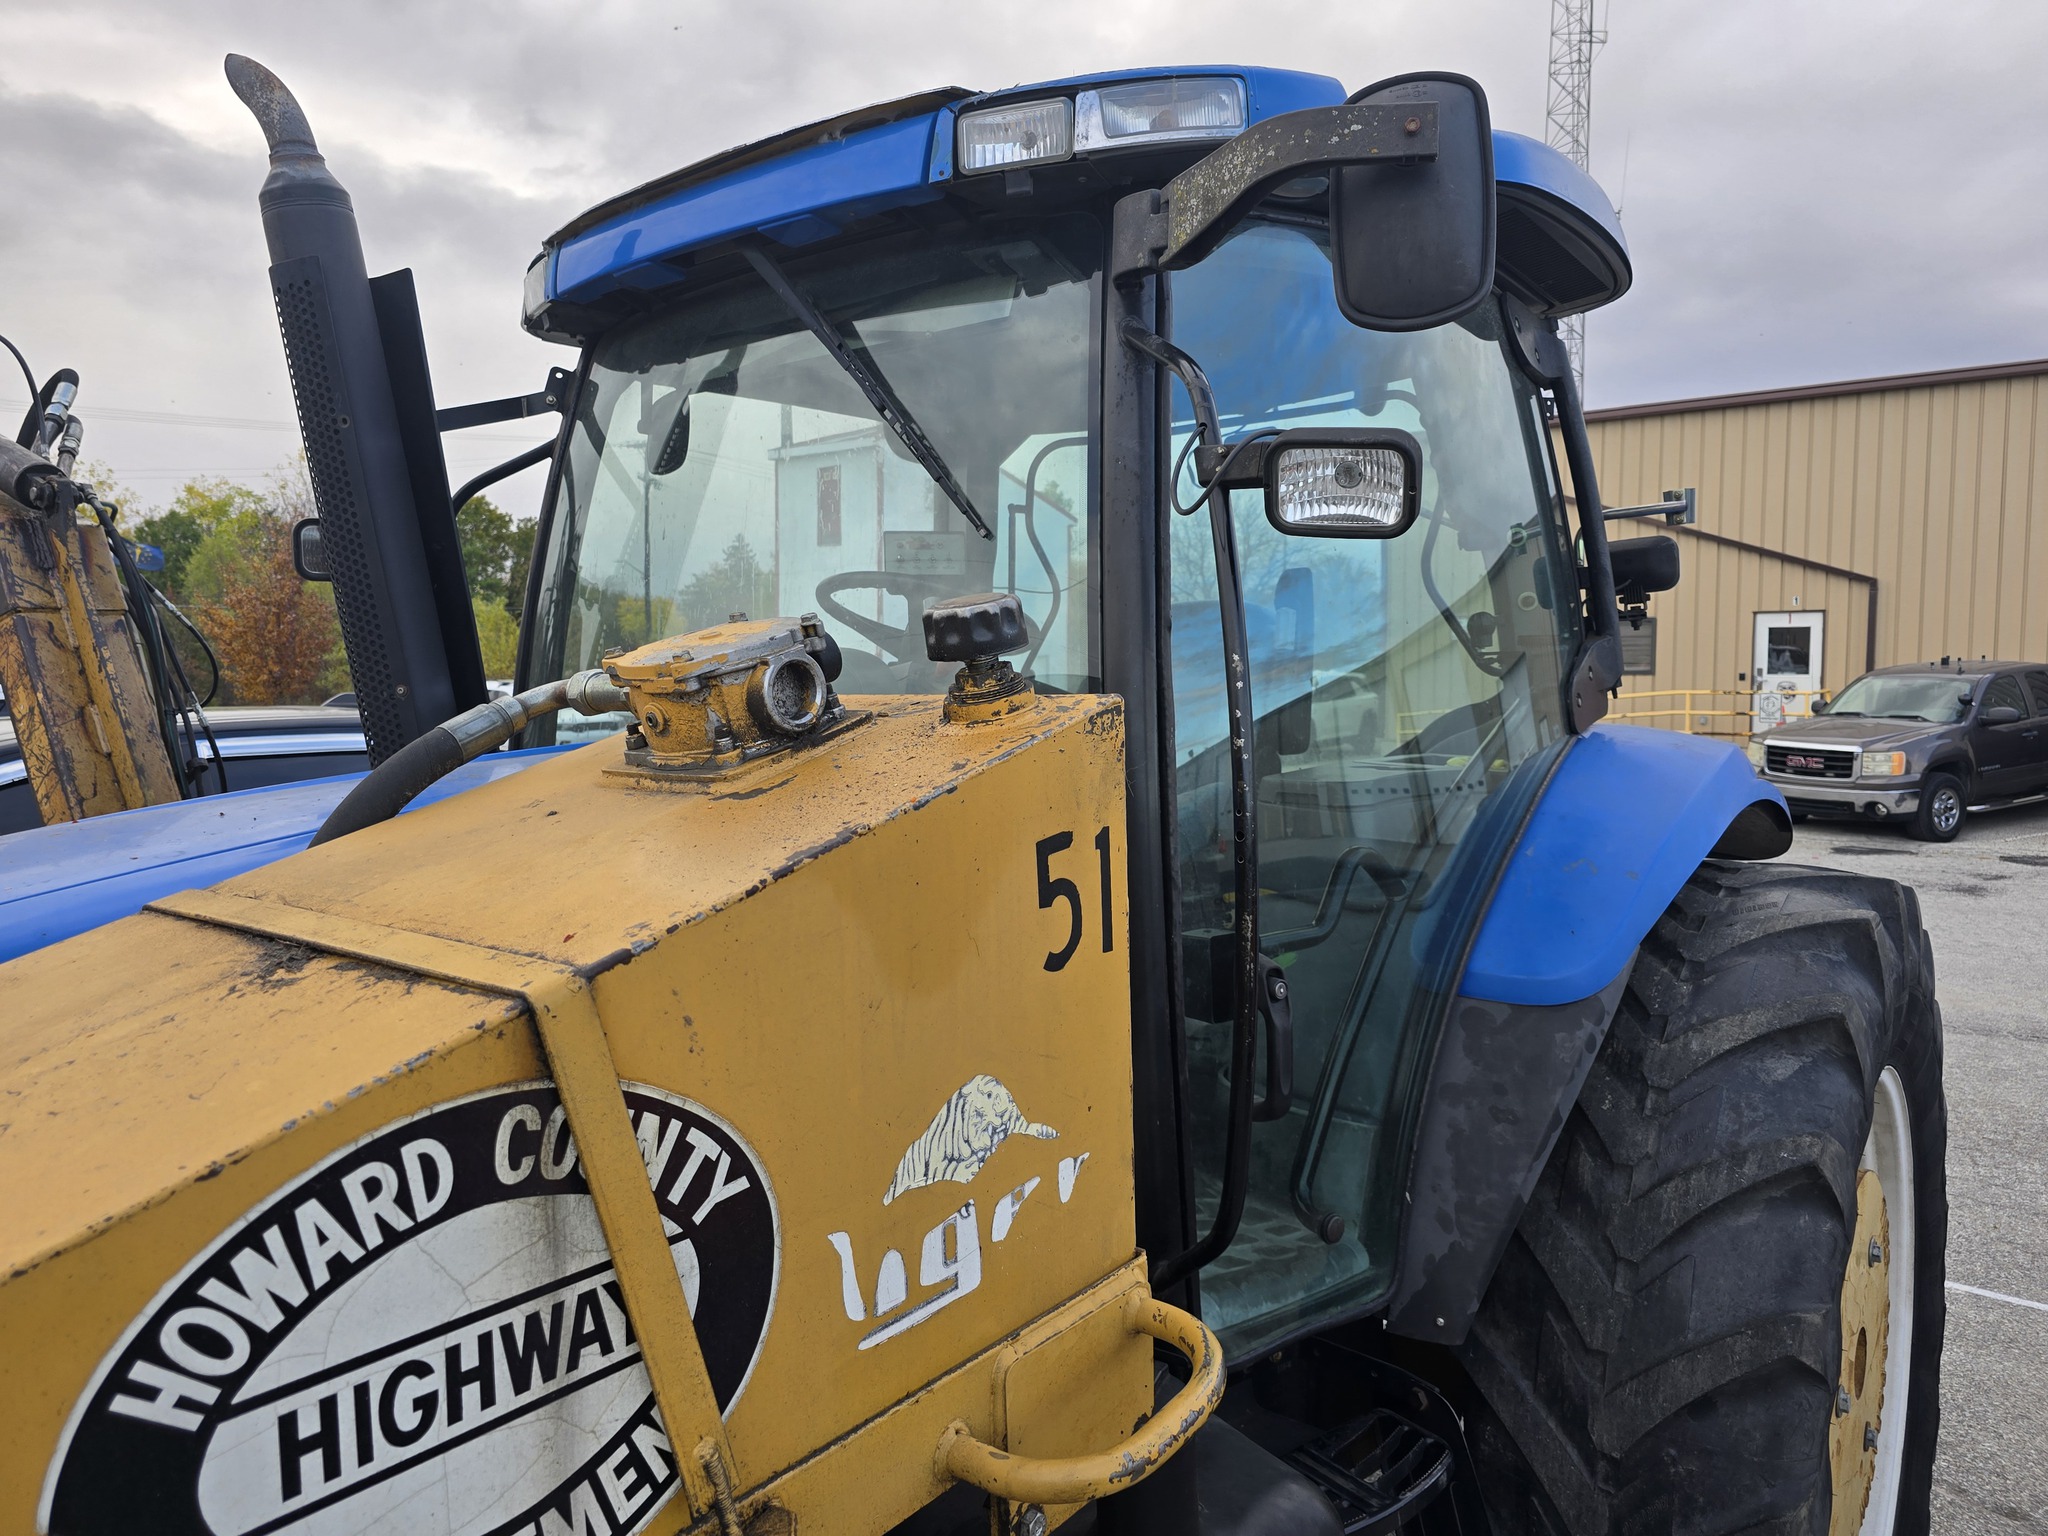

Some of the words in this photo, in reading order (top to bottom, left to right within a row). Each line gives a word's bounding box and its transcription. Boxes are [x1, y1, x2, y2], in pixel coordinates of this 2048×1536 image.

[1785, 754, 1825, 770] GMC
[1035, 825, 1114, 973] 51
[108, 1138, 455, 1432] HOWARD
[494, 1103, 751, 1227] CONTY
[276, 1279, 638, 1504] HIGHWAY
